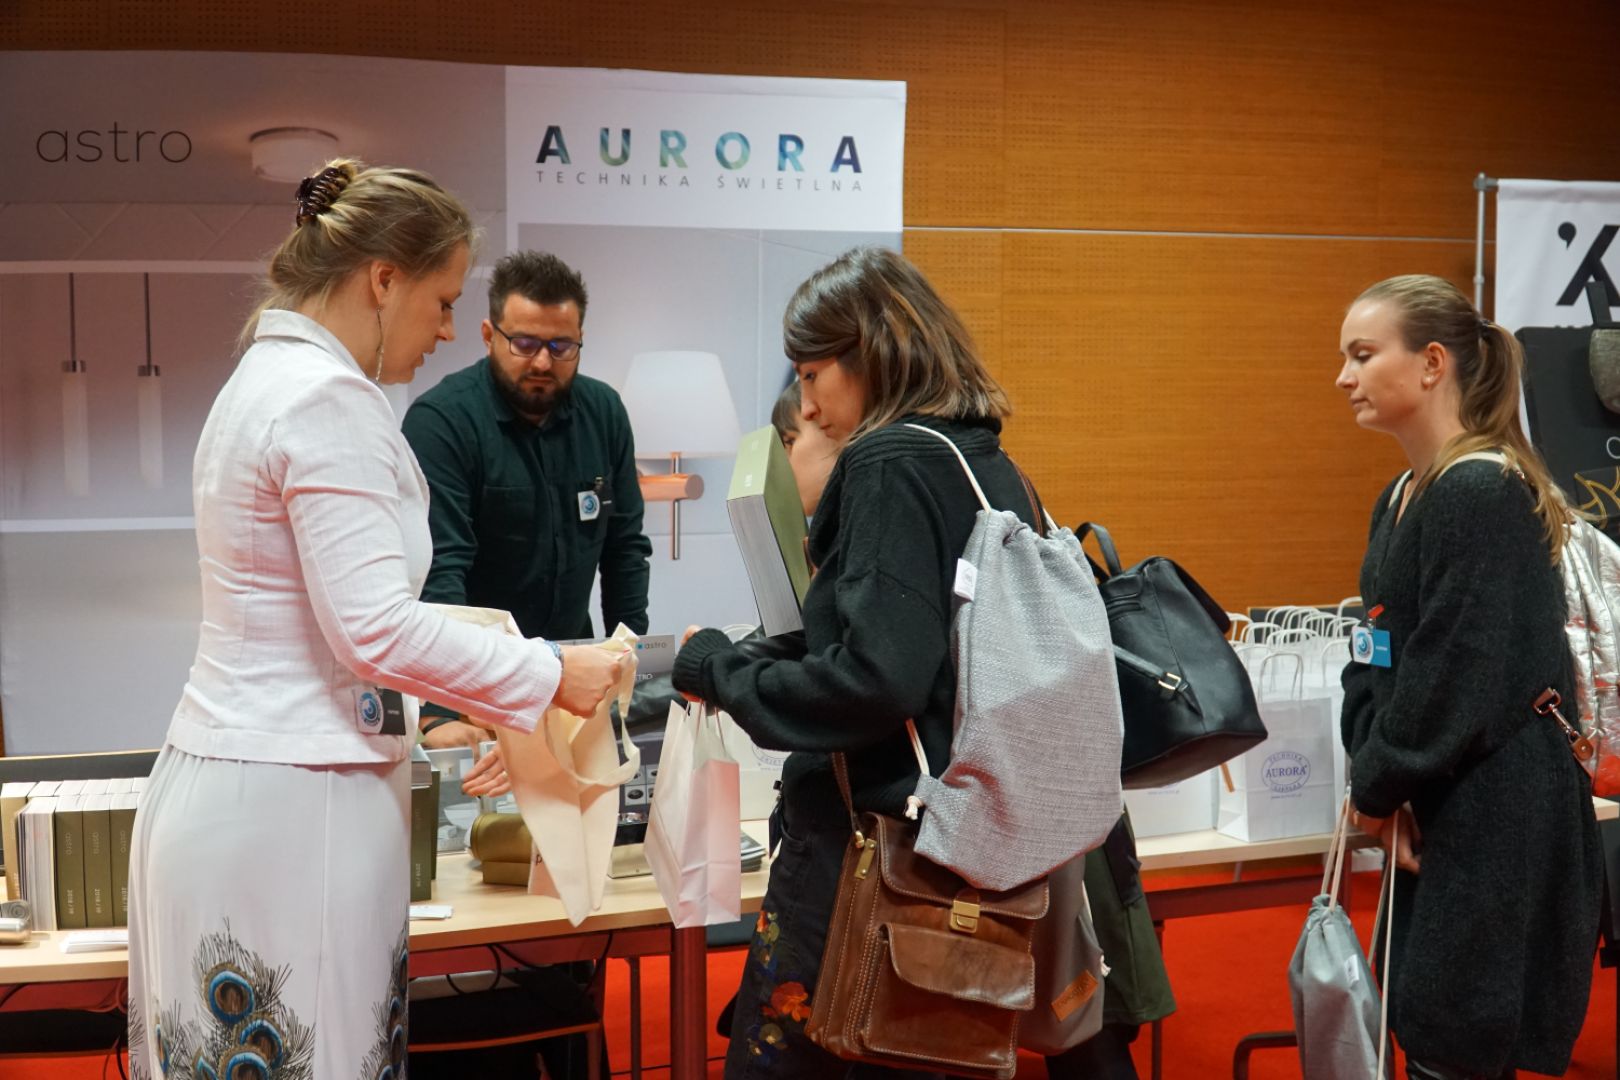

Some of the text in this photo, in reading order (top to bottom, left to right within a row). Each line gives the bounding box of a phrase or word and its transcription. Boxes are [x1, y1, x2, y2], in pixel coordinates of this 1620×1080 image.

[36, 121, 193, 163] astro
[535, 125, 863, 174] AURORA
[536, 171, 863, 192] TECHNIKA ŚWIETLNA
[645, 641, 667, 649] astro
[1265, 766, 1306, 778] AURORA
